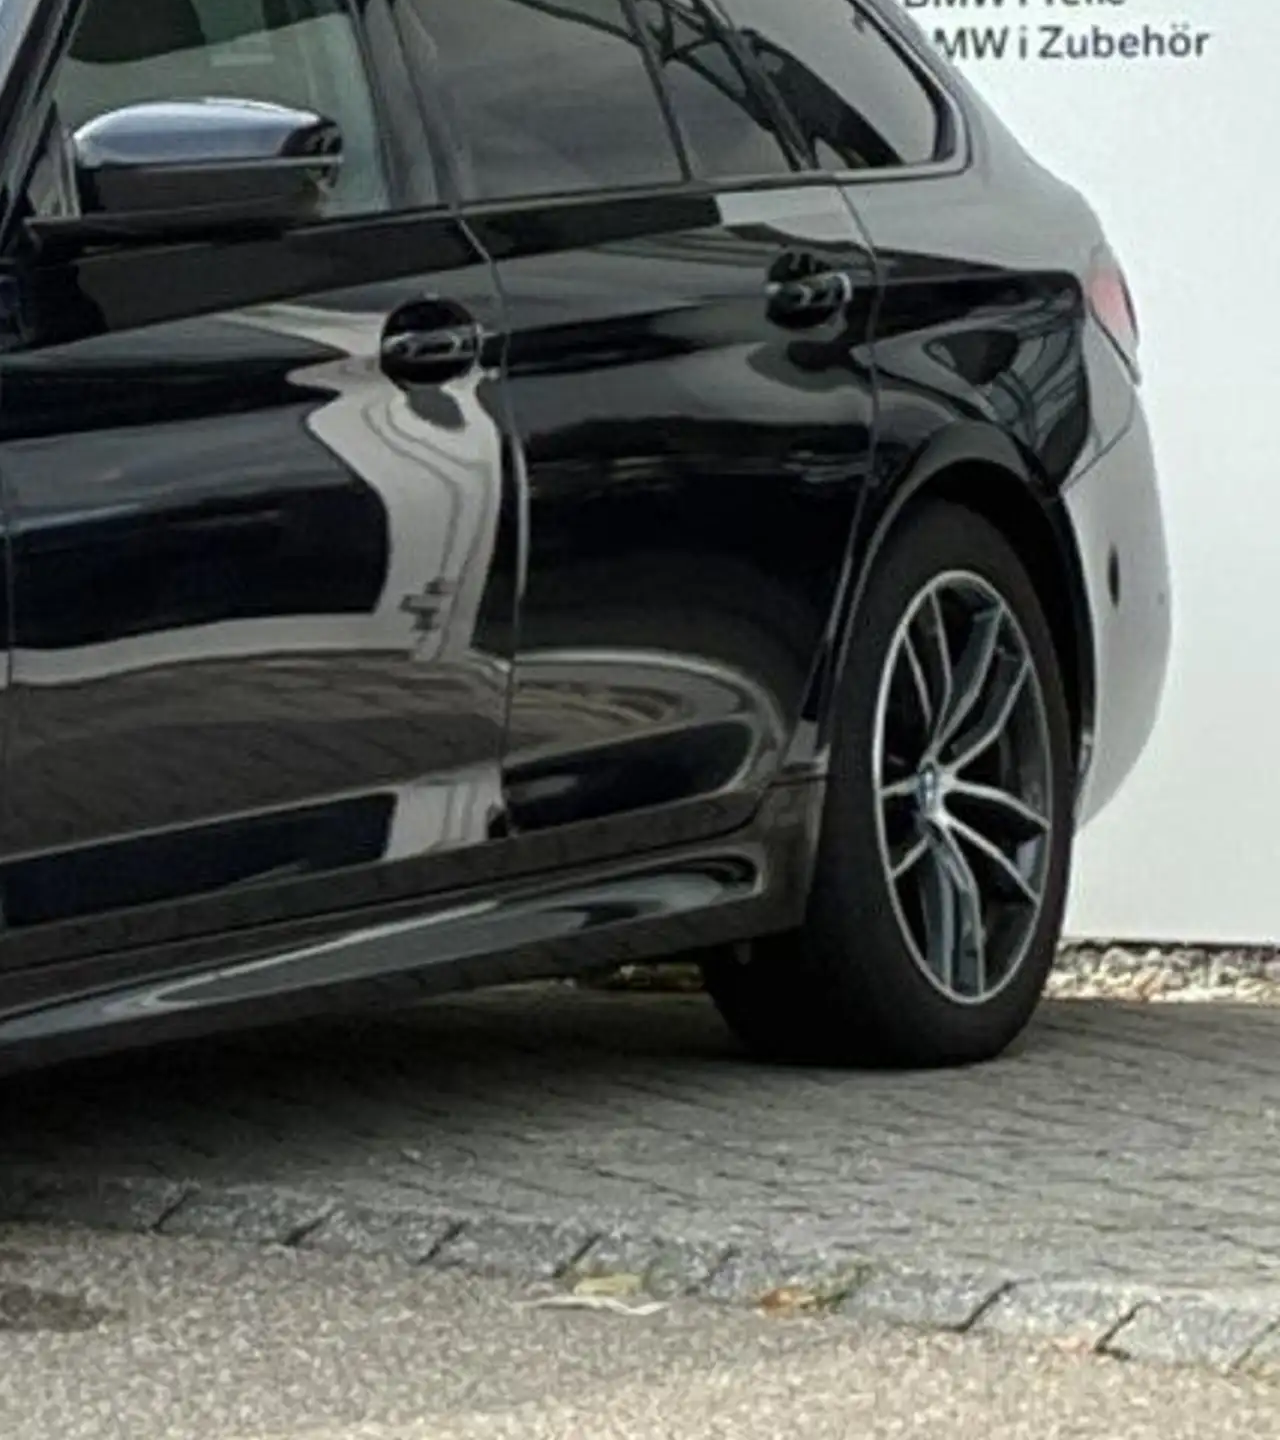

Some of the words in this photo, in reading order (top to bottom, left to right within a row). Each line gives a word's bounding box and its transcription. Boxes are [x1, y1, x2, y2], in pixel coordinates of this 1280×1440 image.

[933, 25, 1010, 60] MW
[1018, 25, 1028, 60] i
[1037, 23, 1211, 60] Zubehör
